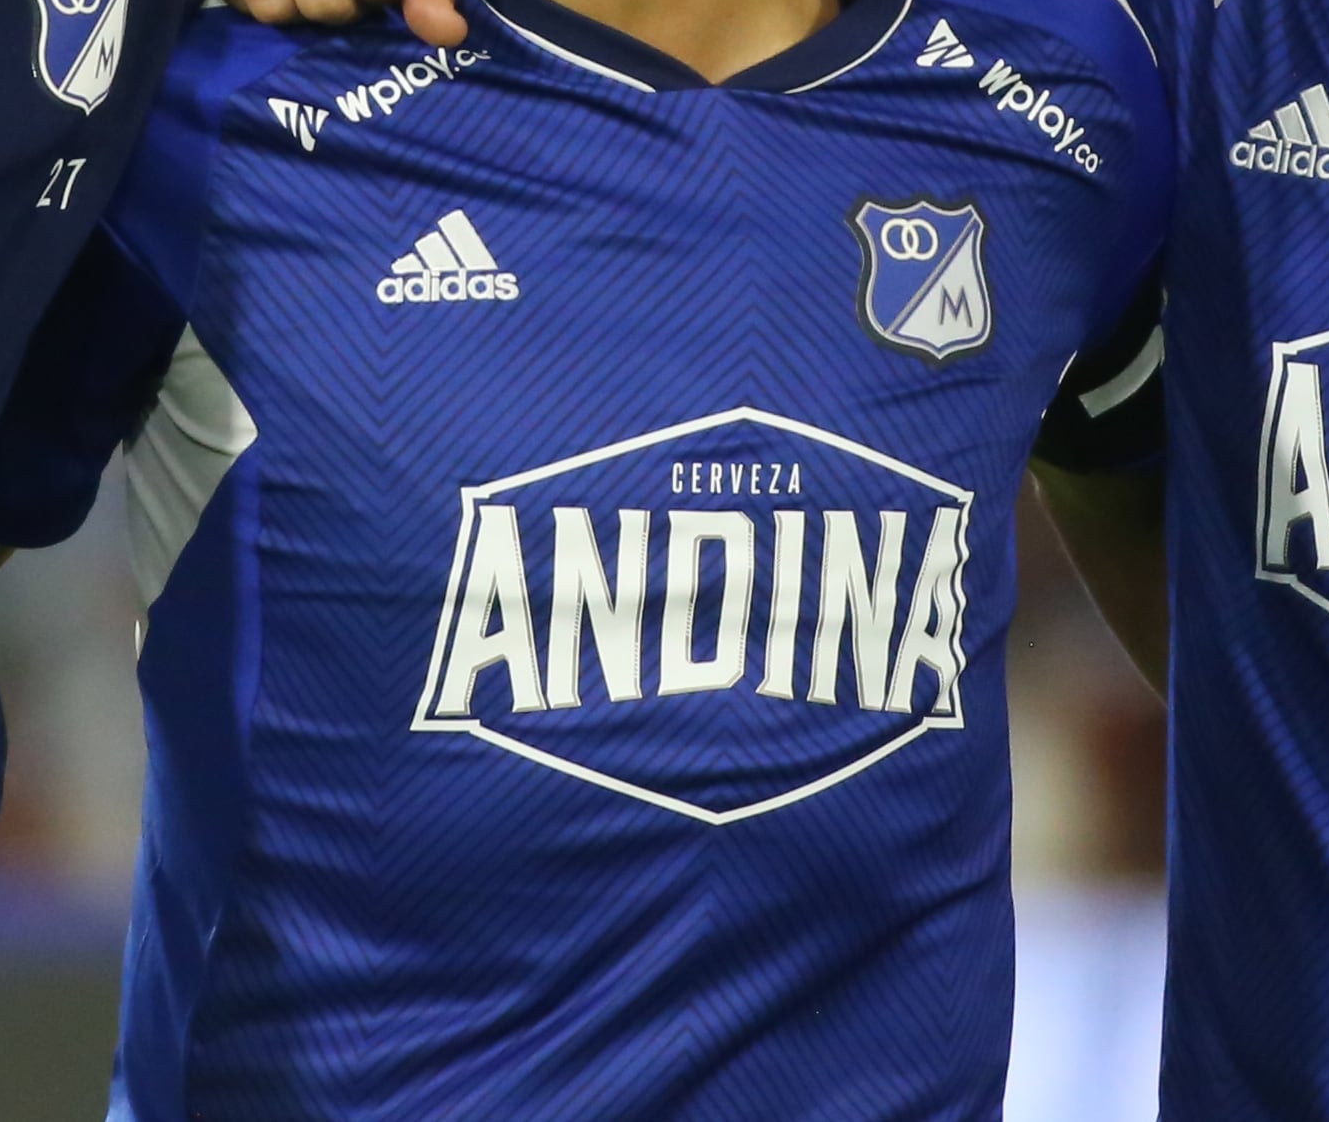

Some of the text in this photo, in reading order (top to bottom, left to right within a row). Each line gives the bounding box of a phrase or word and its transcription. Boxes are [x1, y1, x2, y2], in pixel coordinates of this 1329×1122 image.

[95, 39, 114, 78] M
[978, 58, 1098, 173] wplay.co
[36, 158, 86, 210] 27
[376, 270, 519, 304] adidas
[939, 283, 973, 328] M
[671, 462, 802, 496] CERVEZA
[434, 504, 961, 716] ANDINA
